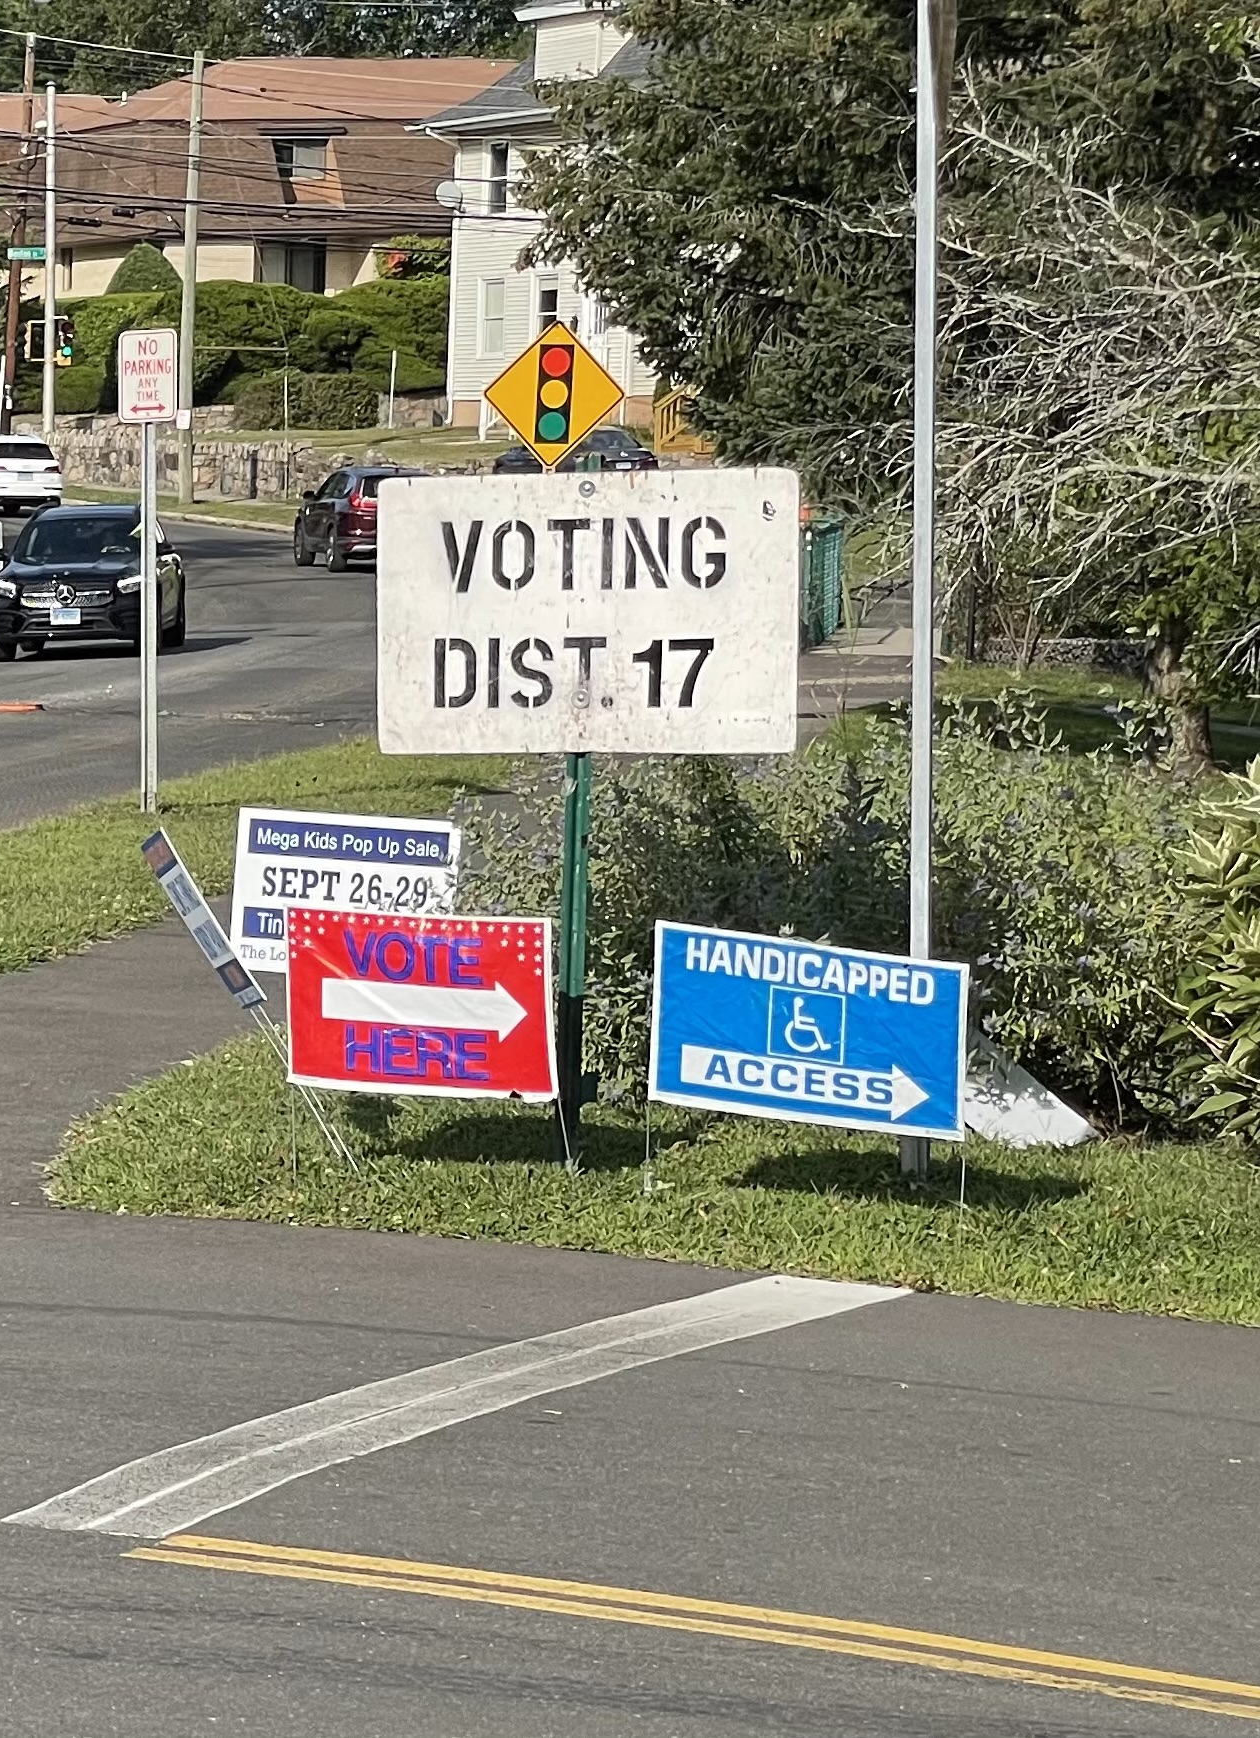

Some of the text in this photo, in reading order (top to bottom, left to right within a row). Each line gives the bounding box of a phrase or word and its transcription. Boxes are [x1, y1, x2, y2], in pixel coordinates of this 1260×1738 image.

[124, 358, 172, 376] PARKING
[138, 339, 158, 356] NO
[136, 390, 160, 401] TIME
[138, 377, 159, 389] ANY
[441, 515, 727, 593] VOTING
[433, 636, 715, 709] DIST. 17
[257, 827, 440, 858] Mega Kids Pop Up Sale
[261, 866, 428, 909] SEPT 26-29
[240, 944, 267, 961] The
[343, 928, 484, 986] VOTE
[686, 936, 935, 1005] HANDICAPPED
[346, 1024, 490, 1081] HERE
[704, 1053, 894, 1105] ACCESS
